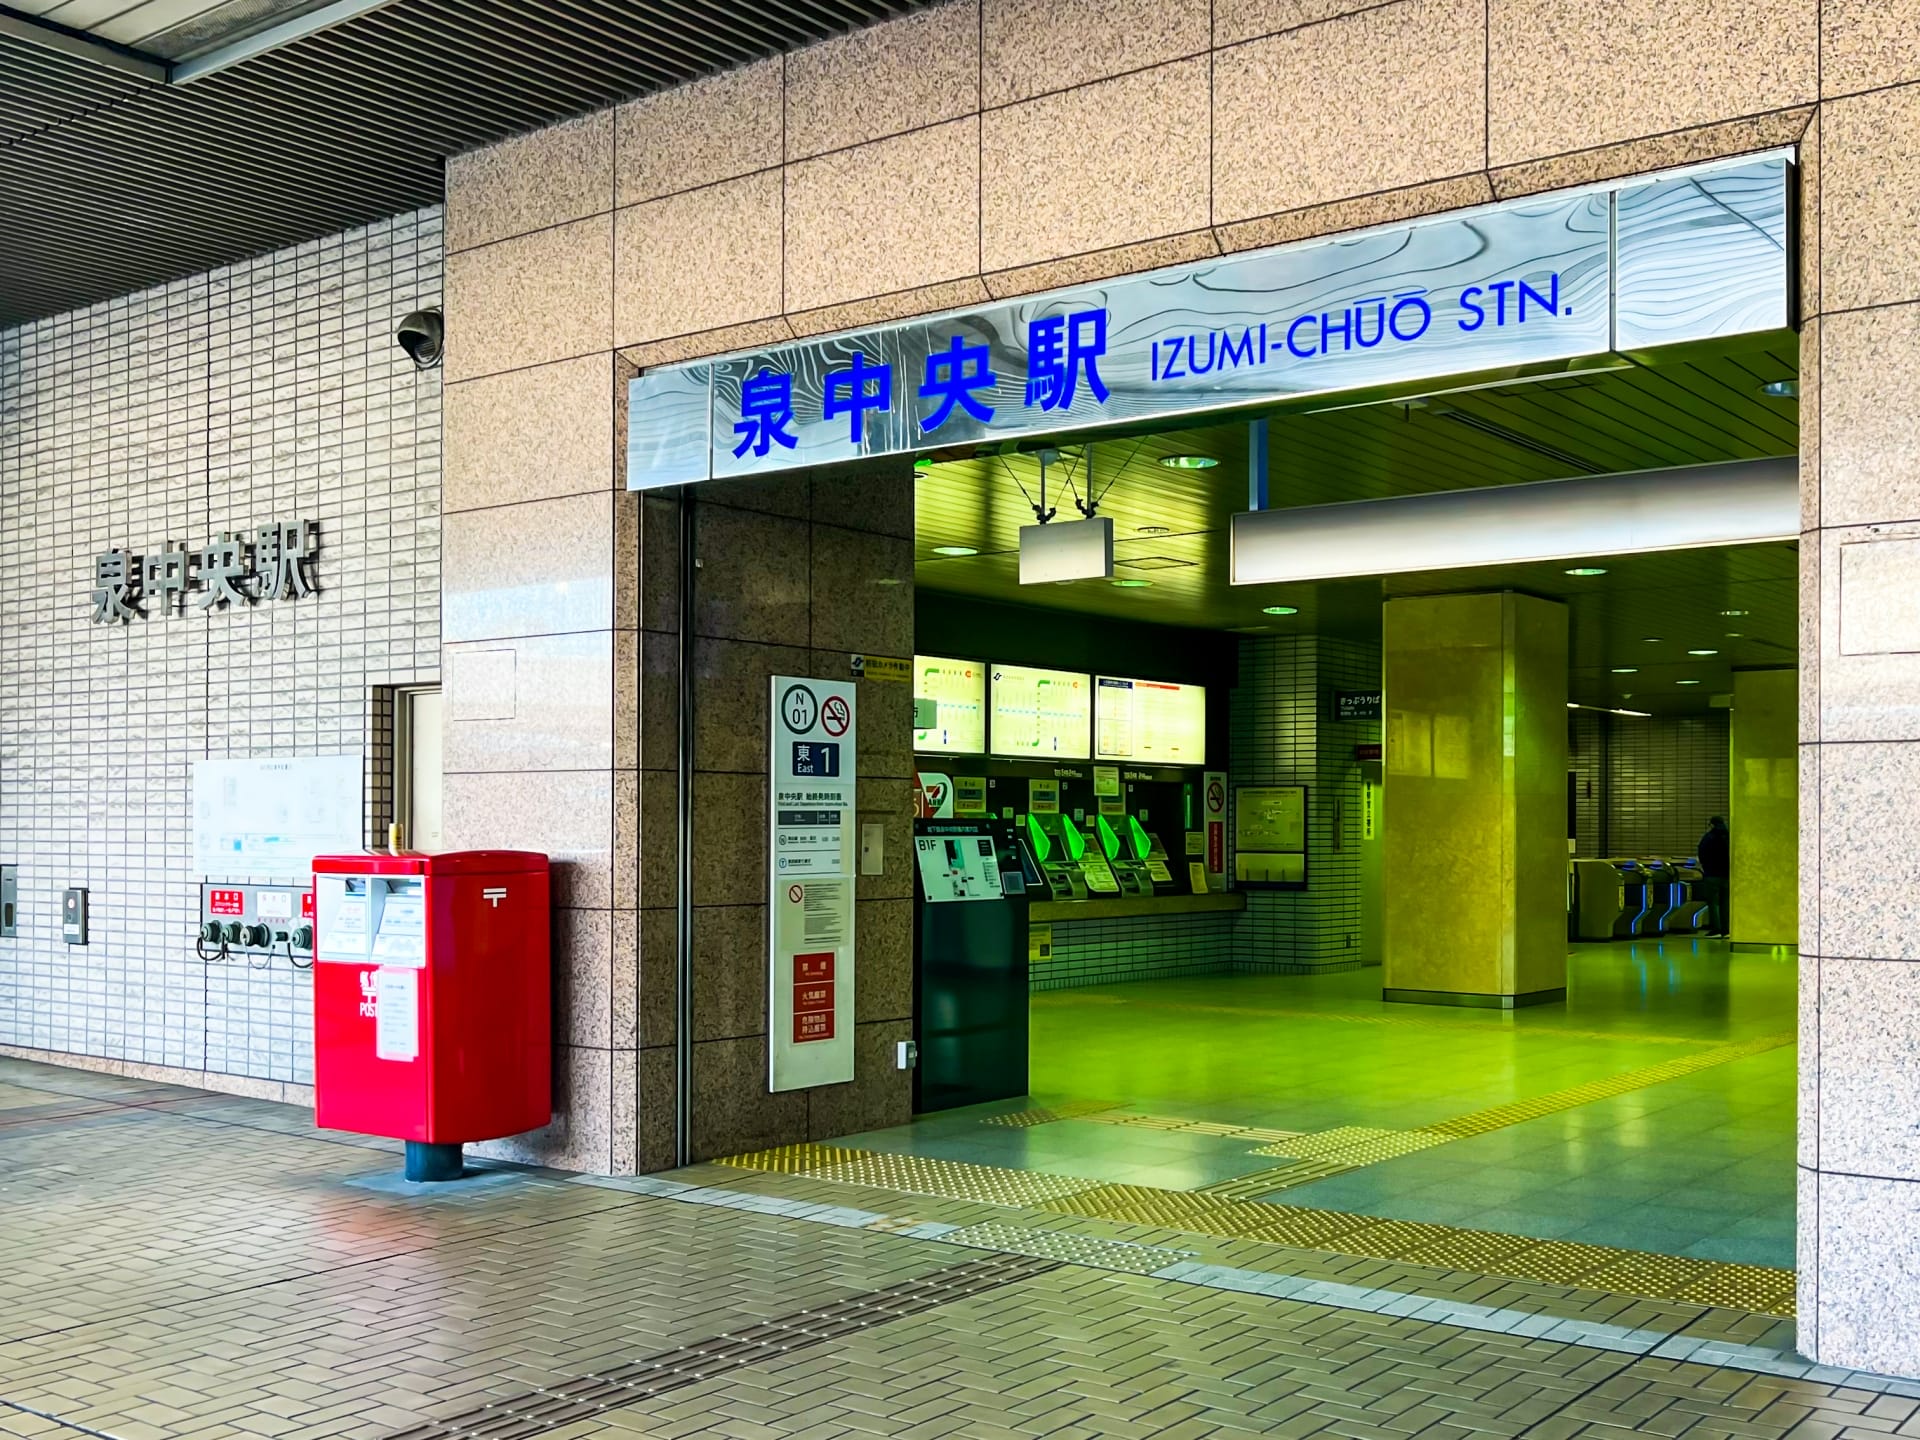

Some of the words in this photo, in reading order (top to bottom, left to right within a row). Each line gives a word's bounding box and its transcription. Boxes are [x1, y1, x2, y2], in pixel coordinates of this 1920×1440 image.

[1152, 290, 1431, 381] IZUMI-CHŪŌ
[1458, 274, 1573, 332] STN.
[732, 308, 1110, 458] 泉中央駅
[91, 519, 312, 624] 泉中央駅
[795, 692, 804, 706] N
[1340, 695, 1381, 705] きっぷうりば
[792, 708, 808, 725] 01
[796, 744, 811, 762] 東
[820, 747, 830, 773] 1
[797, 763, 814, 774] East
[918, 839, 937, 851] B1F
